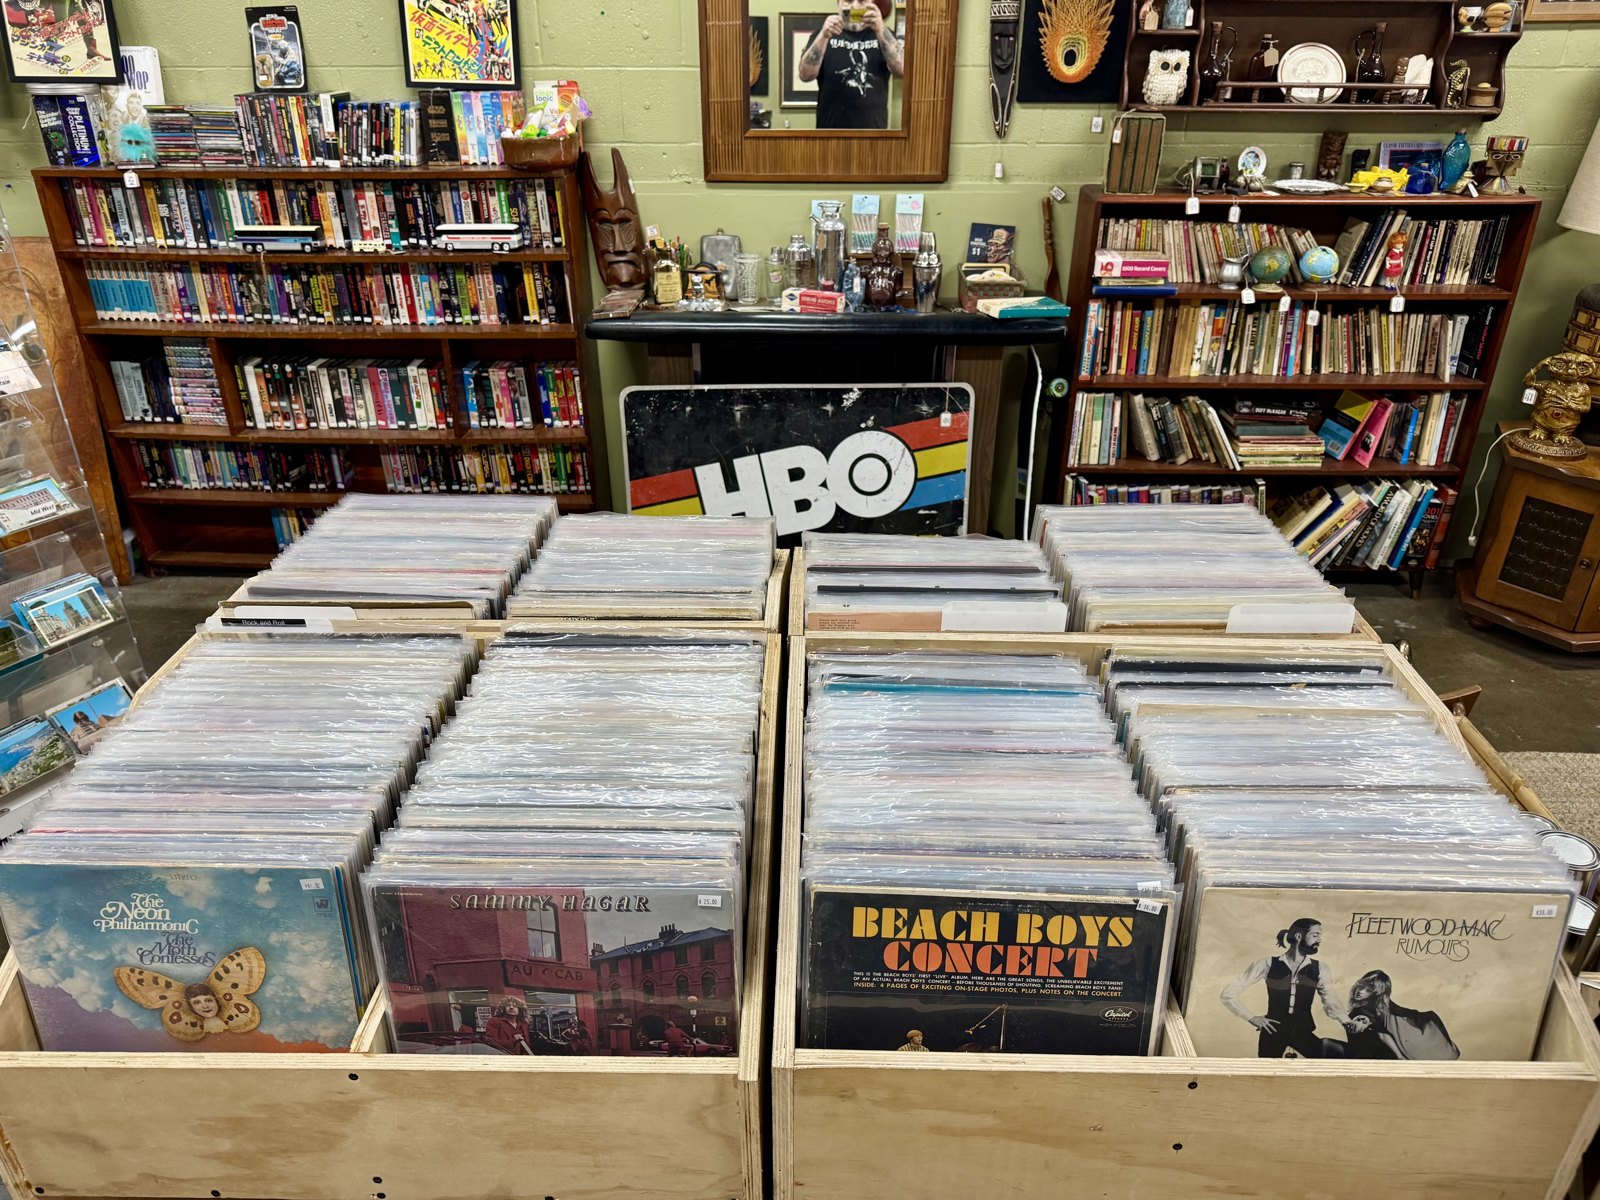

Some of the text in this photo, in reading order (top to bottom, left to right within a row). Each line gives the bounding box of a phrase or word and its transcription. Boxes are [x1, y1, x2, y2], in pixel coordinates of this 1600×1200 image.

[536, 280, 544, 299] RIDER
[694, 430, 916, 536] HBO
[30, 504, 55, 516] Mid West
[100, 900, 170, 921] Neon
[130, 893, 164, 909] The
[450, 893, 651, 912] SAMMY HAGAR
[852, 907, 1134, 948] BEACH BOYS
[1345, 912, 1513, 941] FLEETWOOD MAC
[161, 931, 194, 946] The
[150, 941, 197, 956] Moth
[1396, 938, 1470, 962] RUMOURS
[883, 942, 1098, 978] CONCERT
[555, 969, 584, 981] CAB
[1104, 1010, 1133, 1018] Capitol
